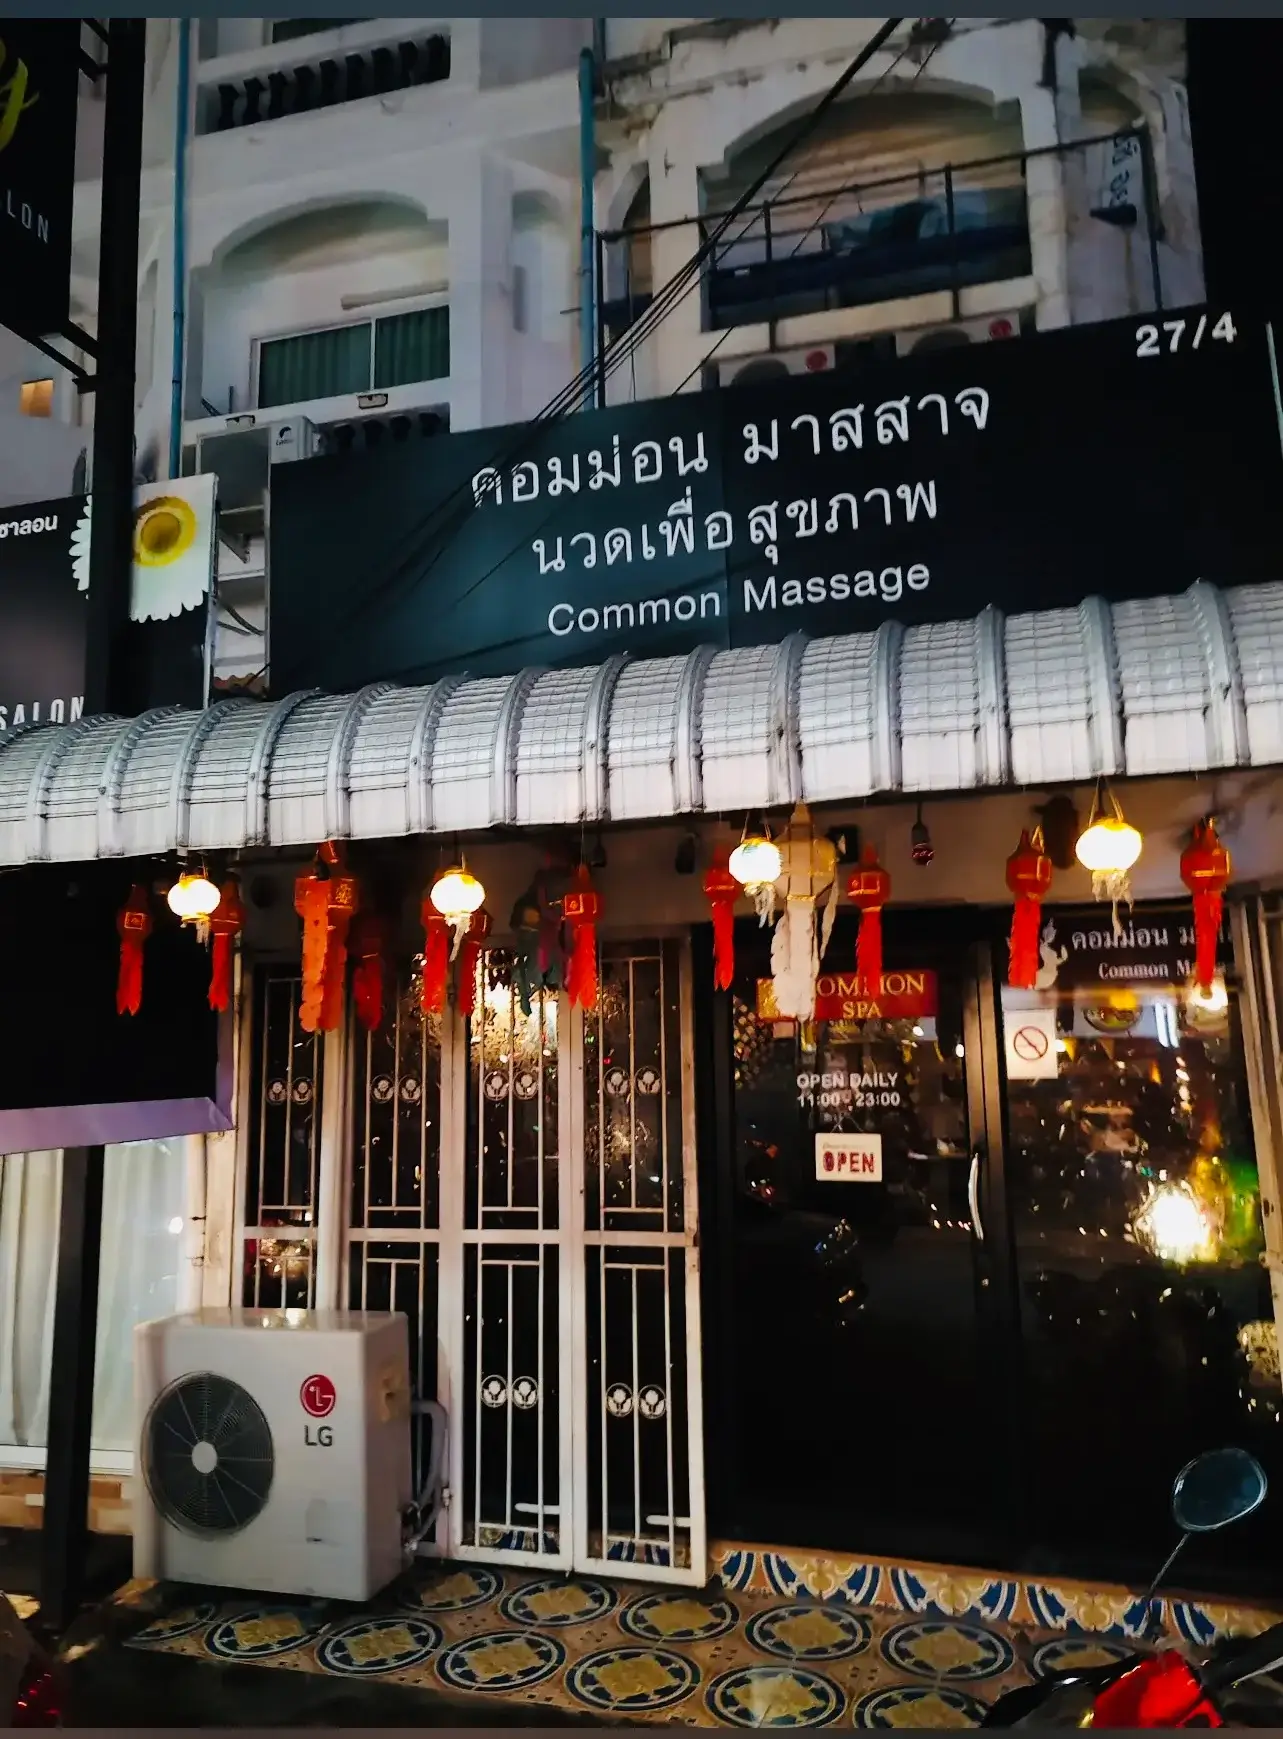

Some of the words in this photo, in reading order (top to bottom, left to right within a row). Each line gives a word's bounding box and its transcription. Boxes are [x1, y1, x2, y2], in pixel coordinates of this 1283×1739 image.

[1135, 311, 1238, 358] 27/4
[743, 386, 989, 464] มาสสาจ
[548, 590, 720, 636] Common
[743, 563, 930, 613] Massage
[1098, 961, 1169, 980] Common
[842, 1001, 882, 1020] SPA
[796, 1070, 845, 1089] OPEN
[849, 1072, 898, 1088] DAILY
[855, 1091, 901, 1108] 23:00
[823, 1151, 875, 1174] OPEN
[304, 1424, 333, 1447] LG
